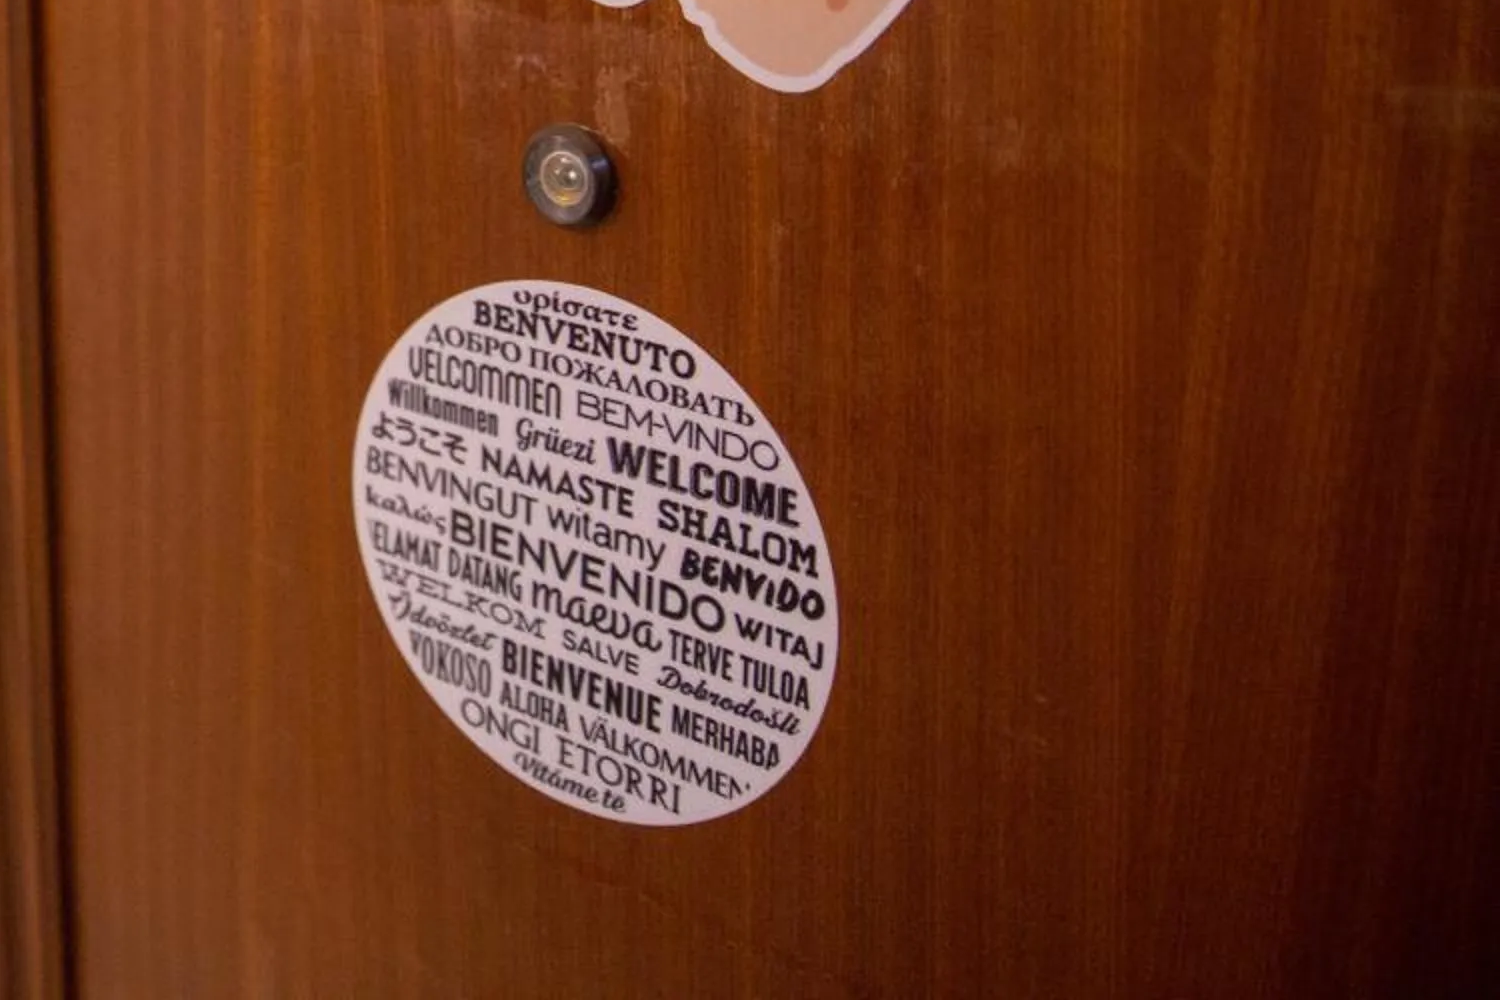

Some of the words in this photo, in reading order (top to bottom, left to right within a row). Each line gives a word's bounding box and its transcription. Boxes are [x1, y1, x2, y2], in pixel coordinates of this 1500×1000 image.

[425, 323, 522, 363] ДОБРО
[529, 345, 756, 428] ПОЖАЛОВАТЬ
[473, 300, 696, 380] BENVENUTO
[371, 411, 468, 465] ようこそ
[387, 377, 499, 437] Willkommen
[515, 417, 596, 465] Grüezi
[606, 436, 800, 528] WELCOME
[408, 346, 562, 420] VELCOMMEN
[576, 390, 780, 471] BEM-VINDO
[366, 445, 539, 526] BENVINGUT
[679, 548, 826, 621] BENVIDO
[481, 443, 635, 519] NAMASTE
[657, 499, 819, 579] SHALOM
[368, 517, 443, 574] ELAMAT
[448, 546, 524, 603] DATANG
[532, 580, 663, 652] maeva
[668, 628, 735, 683] TERVE
[376, 558, 547, 641] WELKOM
[562, 629, 641, 677] SALVE
[450, 508, 726, 633] BIENVENIDO
[733, 612, 826, 671] WITAJ
[501, 681, 570, 733] ALOHA
[502, 637, 663, 735] BIENVENUE
[460, 698, 541, 755] ONGI
[556, 735, 682, 816] ETORRI
